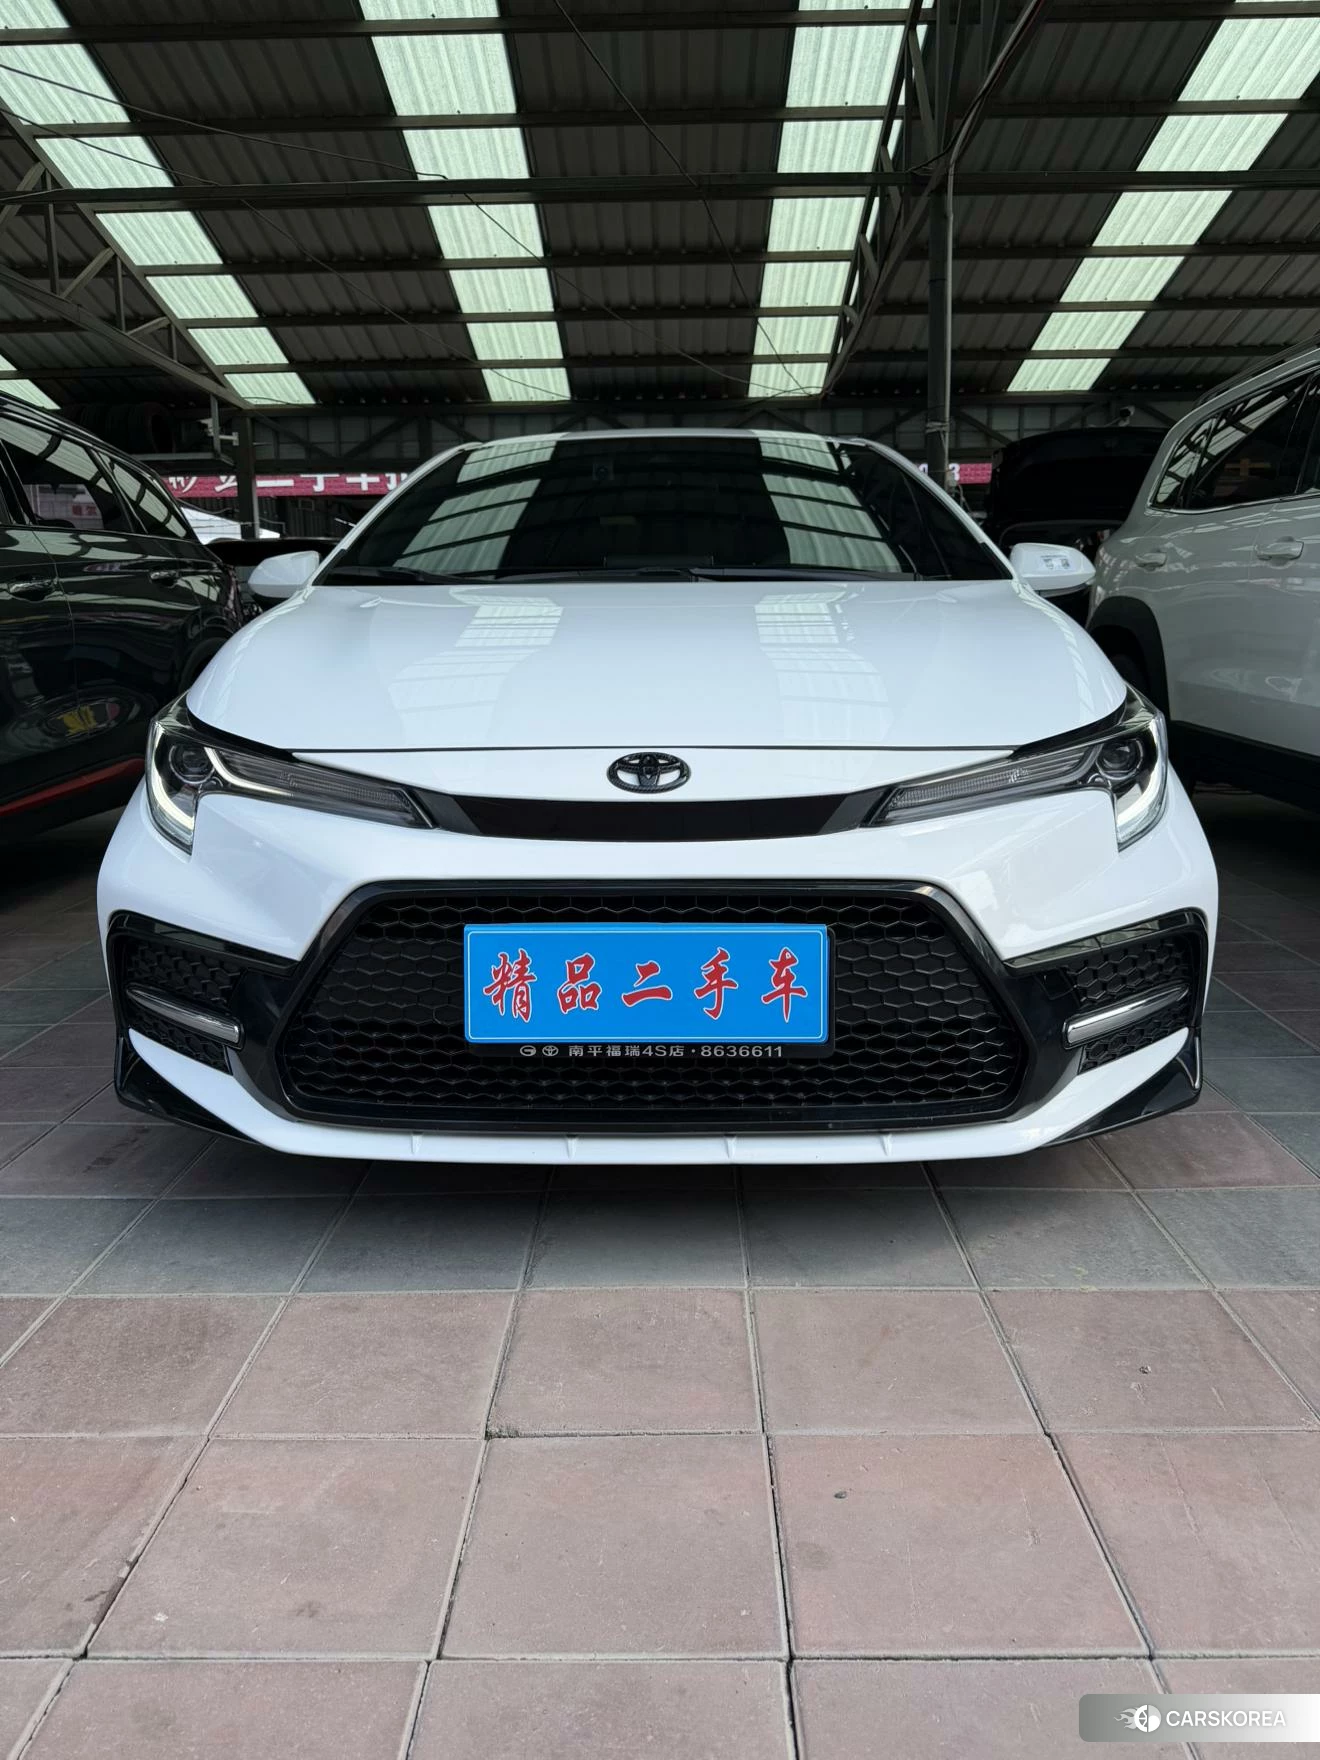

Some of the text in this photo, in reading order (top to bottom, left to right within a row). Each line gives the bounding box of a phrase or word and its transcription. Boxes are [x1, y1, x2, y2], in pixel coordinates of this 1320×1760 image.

[482, 948, 808, 1023] 精品二手车
